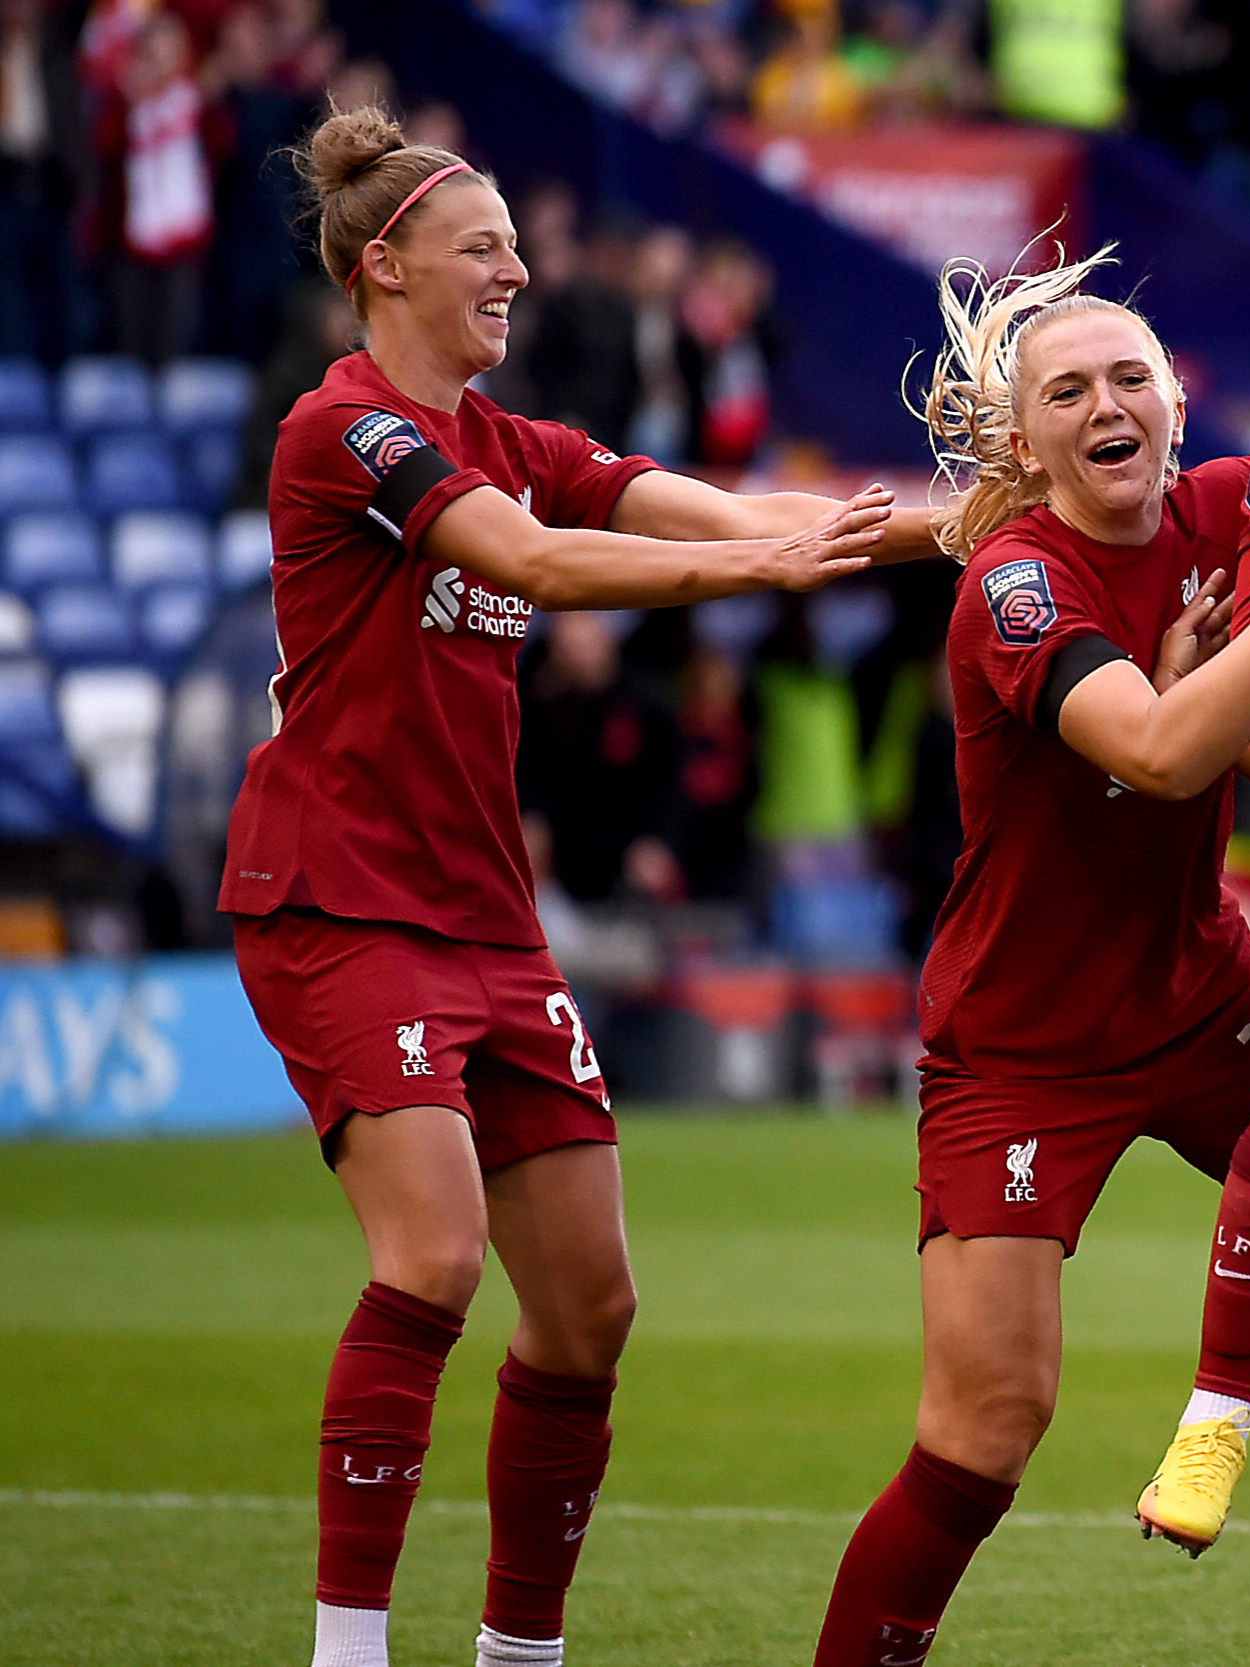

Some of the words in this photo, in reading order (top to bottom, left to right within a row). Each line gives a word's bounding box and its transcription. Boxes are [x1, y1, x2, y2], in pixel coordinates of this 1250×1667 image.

[995, 562, 1037, 581] BARCLAYS
[467, 609, 529, 638] charte
[546, 991, 601, 1084] 2
